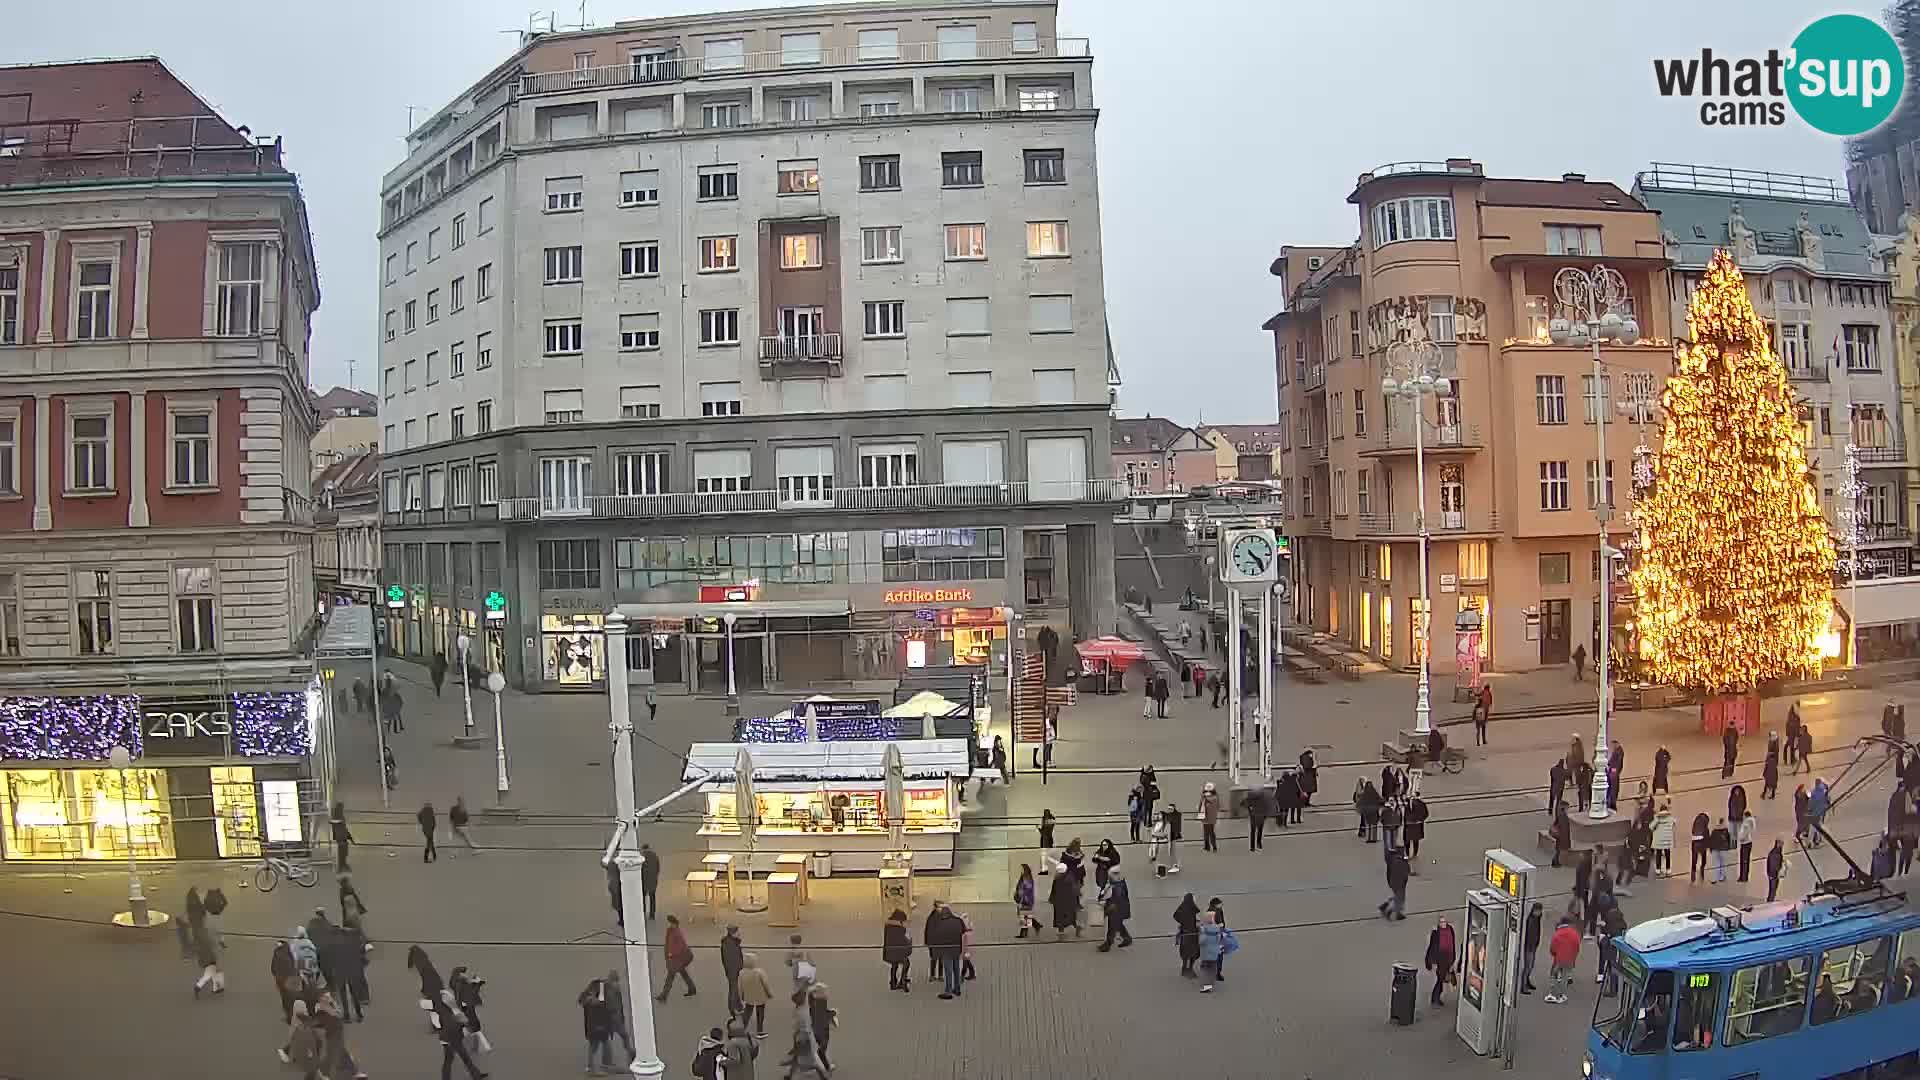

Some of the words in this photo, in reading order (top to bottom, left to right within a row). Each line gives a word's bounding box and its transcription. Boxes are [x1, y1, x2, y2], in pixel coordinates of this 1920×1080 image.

[884, 589, 934, 603] Addiko
[935, 588, 972, 601] Bank
[145, 712, 232, 738] ZAKS
